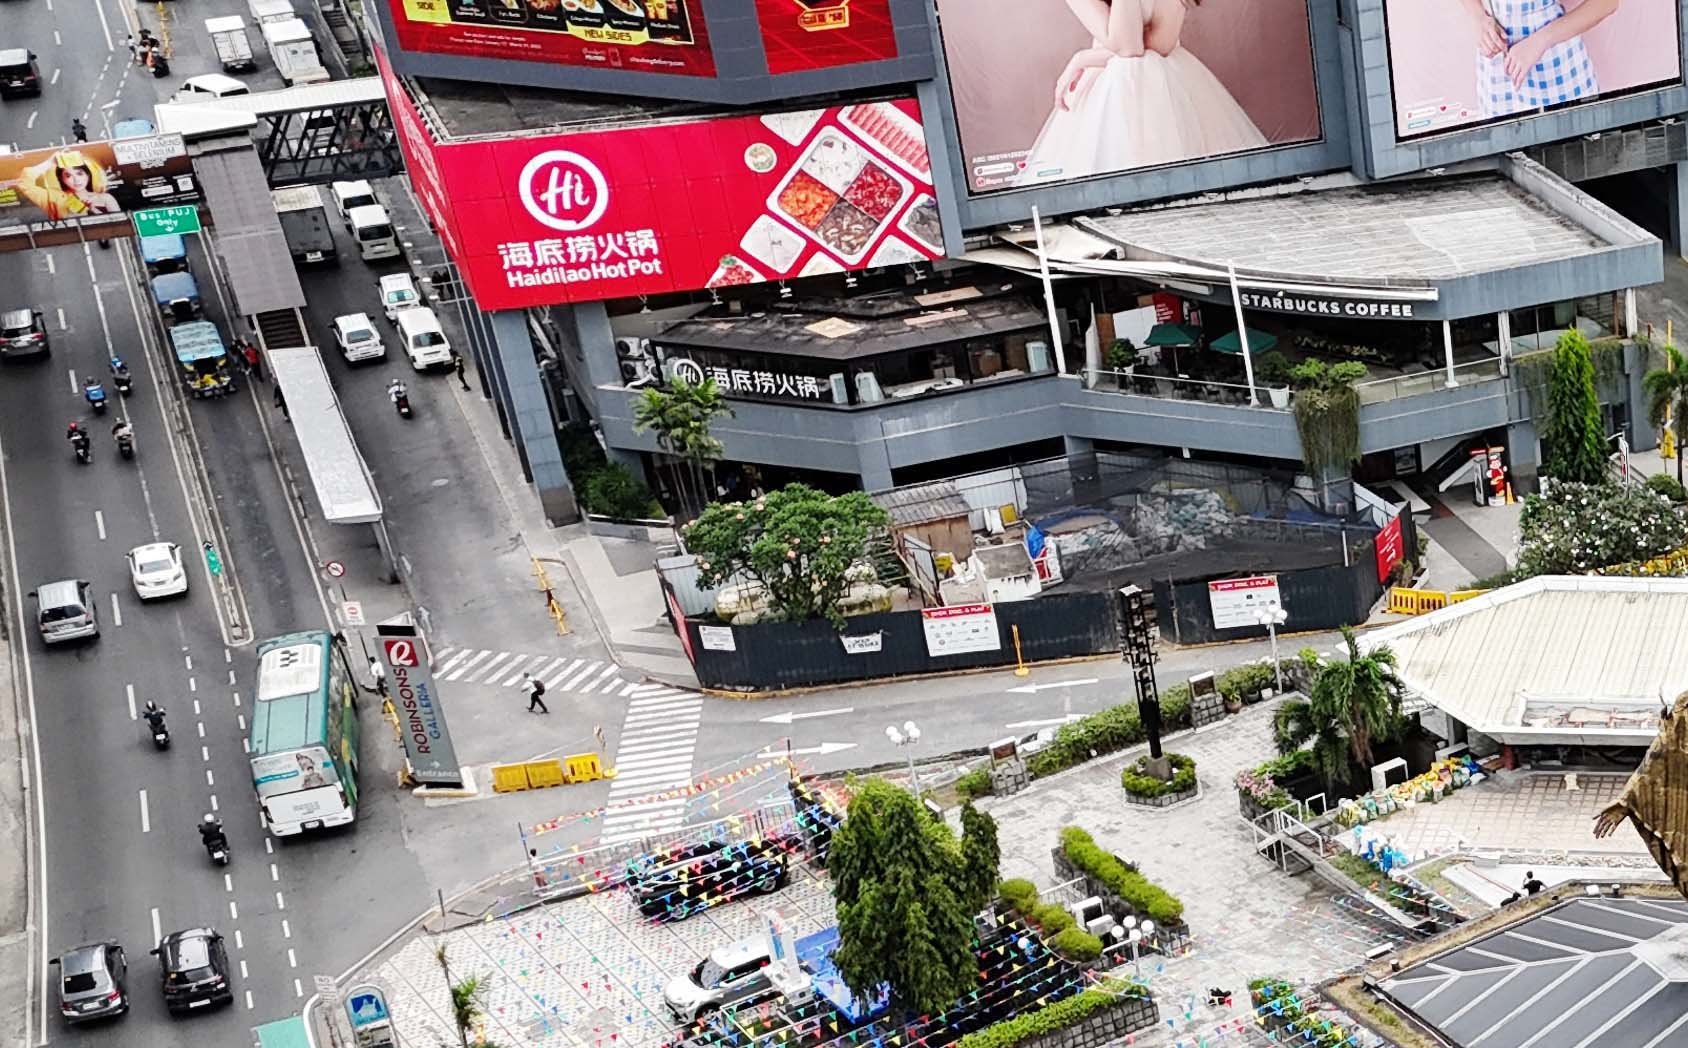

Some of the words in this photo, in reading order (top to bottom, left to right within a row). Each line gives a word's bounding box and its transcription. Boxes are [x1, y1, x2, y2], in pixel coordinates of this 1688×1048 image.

[540, 166, 590, 214] Hi
[497, 229, 659, 270] 海底捞火锅
[1240, 293, 1340, 315] STARBUCKS
[1344, 302, 1413, 318] COFFEE
[706, 366, 820, 399] 海底捞火锅
[393, 666, 431, 755] ROBINSONS
[416, 682, 441, 740] GALLERIA
